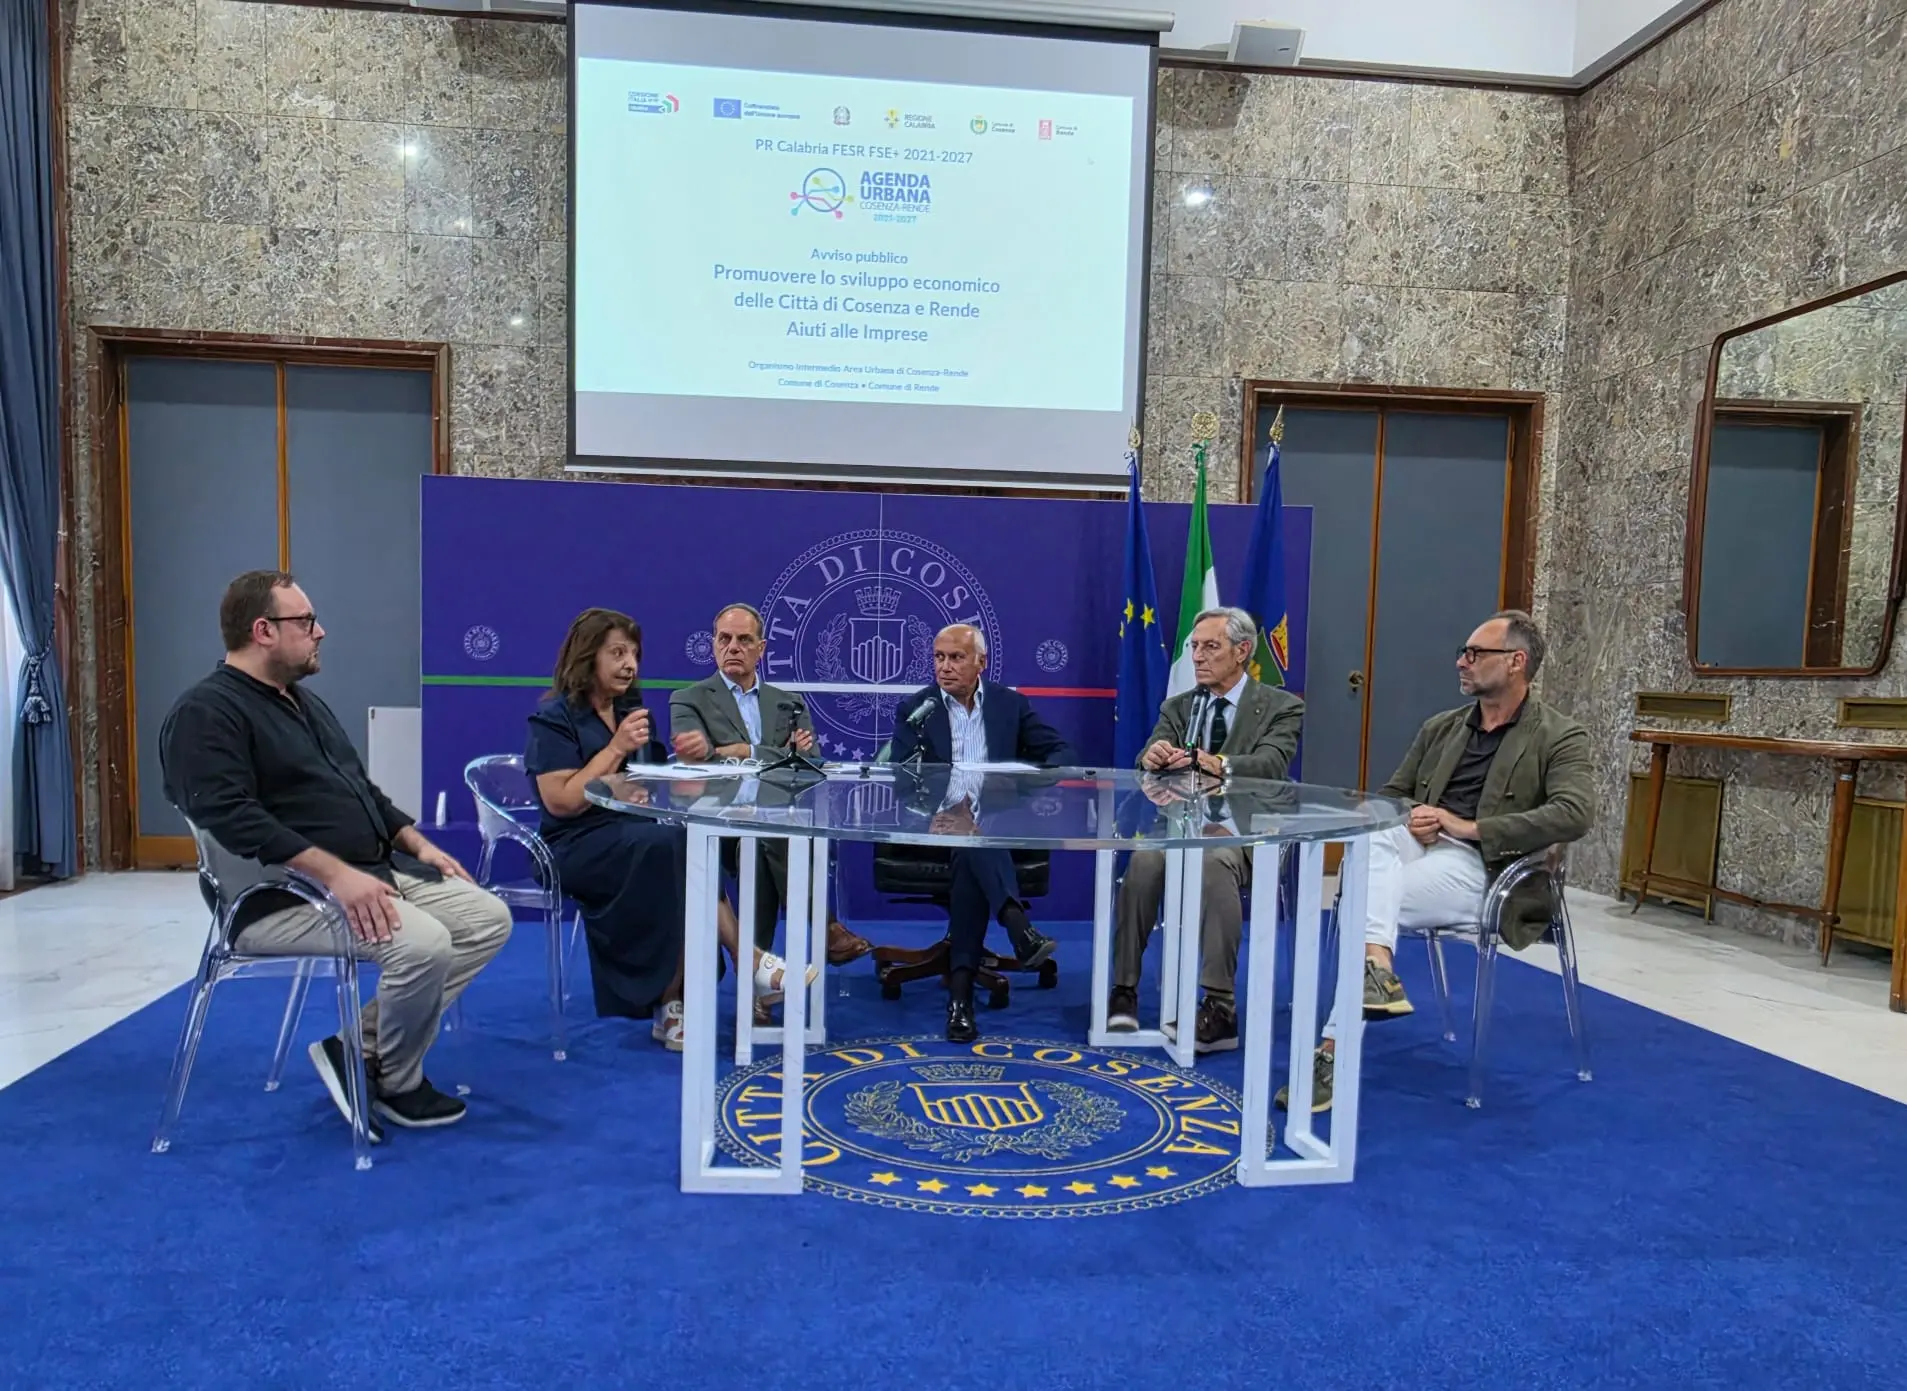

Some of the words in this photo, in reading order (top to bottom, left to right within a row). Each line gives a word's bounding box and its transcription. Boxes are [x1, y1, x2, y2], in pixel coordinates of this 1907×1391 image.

[755, 139, 773, 151] PR
[777, 140, 829, 155] Calabria
[832, 143, 865, 158] FESR
[869, 145, 899, 159] FSE+
[904, 148, 973, 164] 2021-2027
[860, 171, 931, 189] AGENDA
[860, 186, 931, 204] URBANA
[810, 248, 853, 262] Avviso
[855, 251, 908, 265] pubblico
[714, 264, 816, 285] Promuovere
[821, 270, 835, 286] lo
[840, 272, 908, 291] sviluppo
[913, 277, 1000, 293] economico
[734, 292, 774, 308] delle
[778, 294, 818, 311] Città
[823, 296, 838, 311] di
[842, 298, 910, 315] Cosenza
[915, 304, 925, 315] e
[929, 301, 980, 318] Rende
[786, 321, 827, 338] Aiuti
[830, 323, 859, 339] alle
[864, 325, 928, 342] Imprese
[748, 361, 794, 371] Organismo
[796, 363, 841, 373] Intermedio
[843, 365, 863, 374] Area
[865, 366, 895, 375] Urbana
[896, 367, 905, 375] di
[906, 368, 969, 377] Cosenza-Rende
[778, 378, 812, 387] Comune
[815, 379, 823, 388] di
[824, 380, 858, 389] Cosenza
[868, 382, 902, 391] Comune
[904, 383, 912, 391] di
[914, 384, 939, 392] Rende
[767, 594, 812, 675] TTA
[814, 545, 868, 586] DI
[825, 1043, 928, 1066] DI
[971, 1043, 1240, 1156] COSENZA
